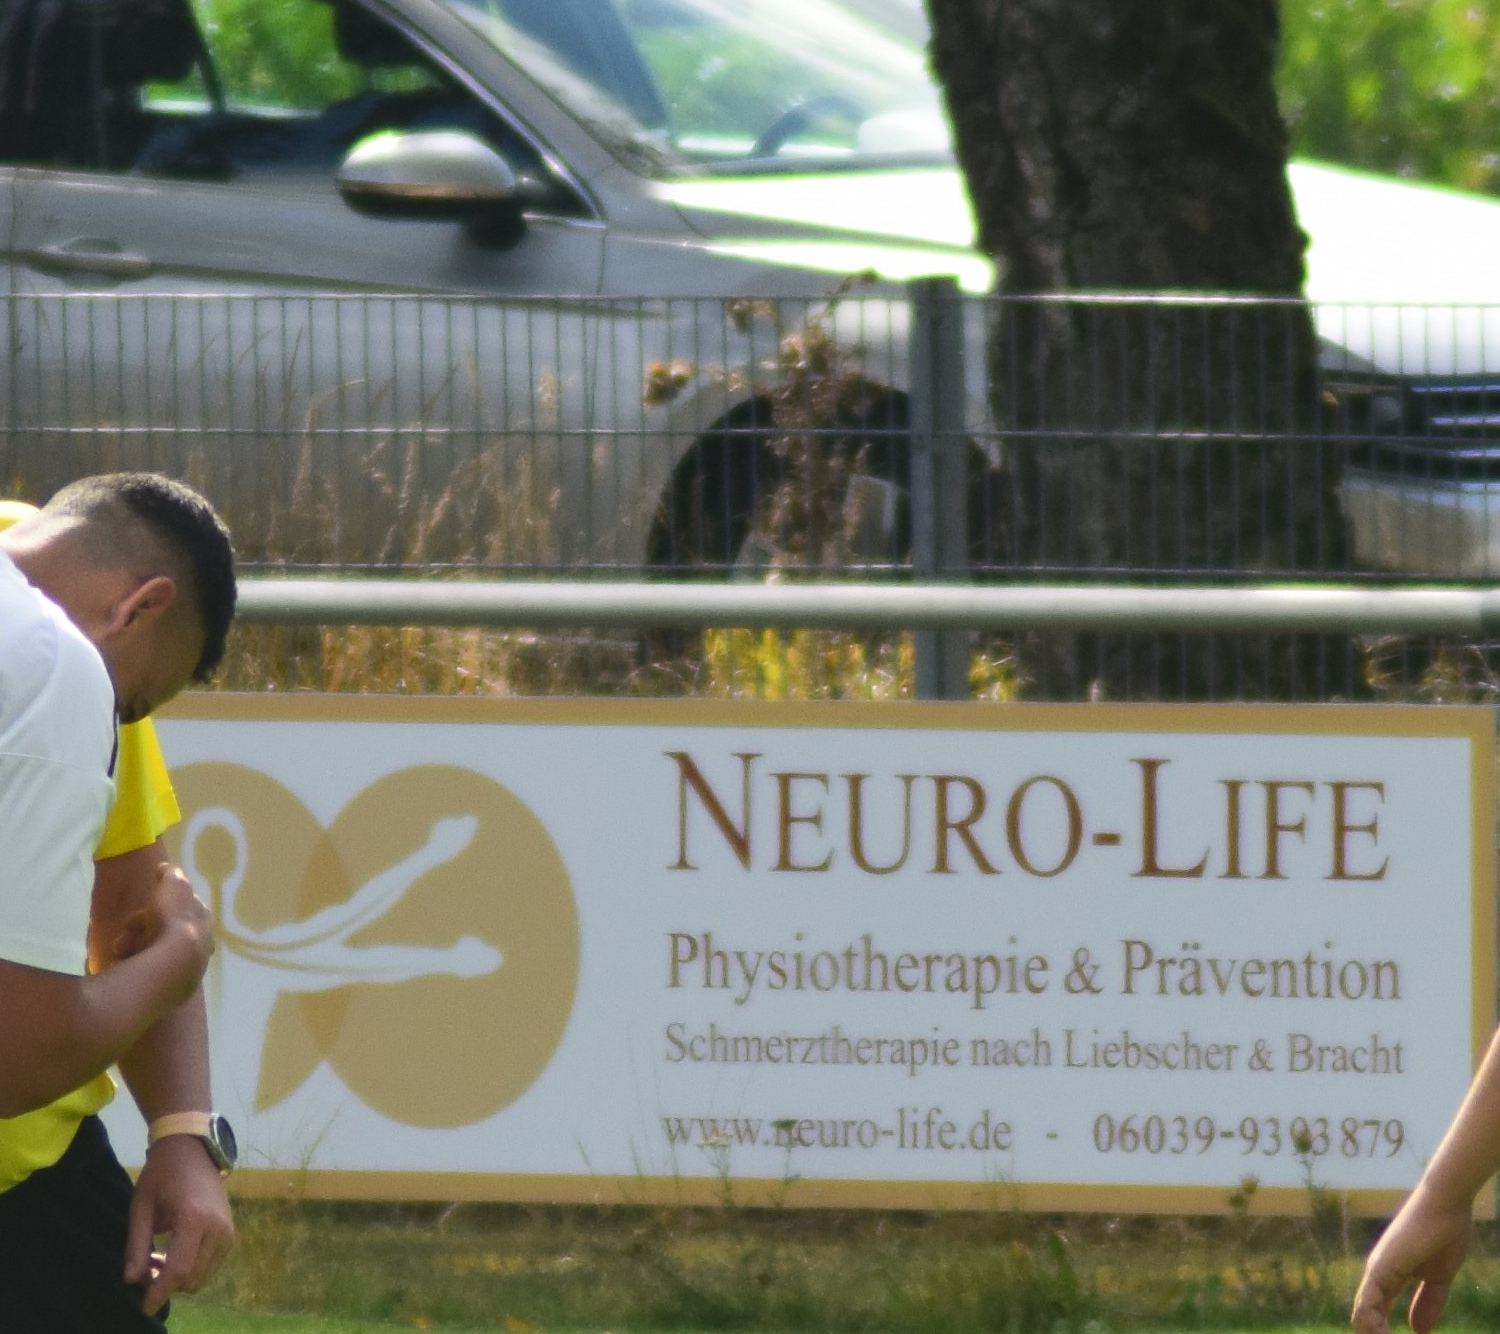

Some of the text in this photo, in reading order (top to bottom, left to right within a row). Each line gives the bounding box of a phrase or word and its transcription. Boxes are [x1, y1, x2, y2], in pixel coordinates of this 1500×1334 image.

[661, 750, 1392, 882] NEURO-LIFE
[664, 931, 1404, 1010] Physiotherapie & Prävention
[664, 1022, 1406, 1077] Schmerztherapie nach Liebscher & Bracht
